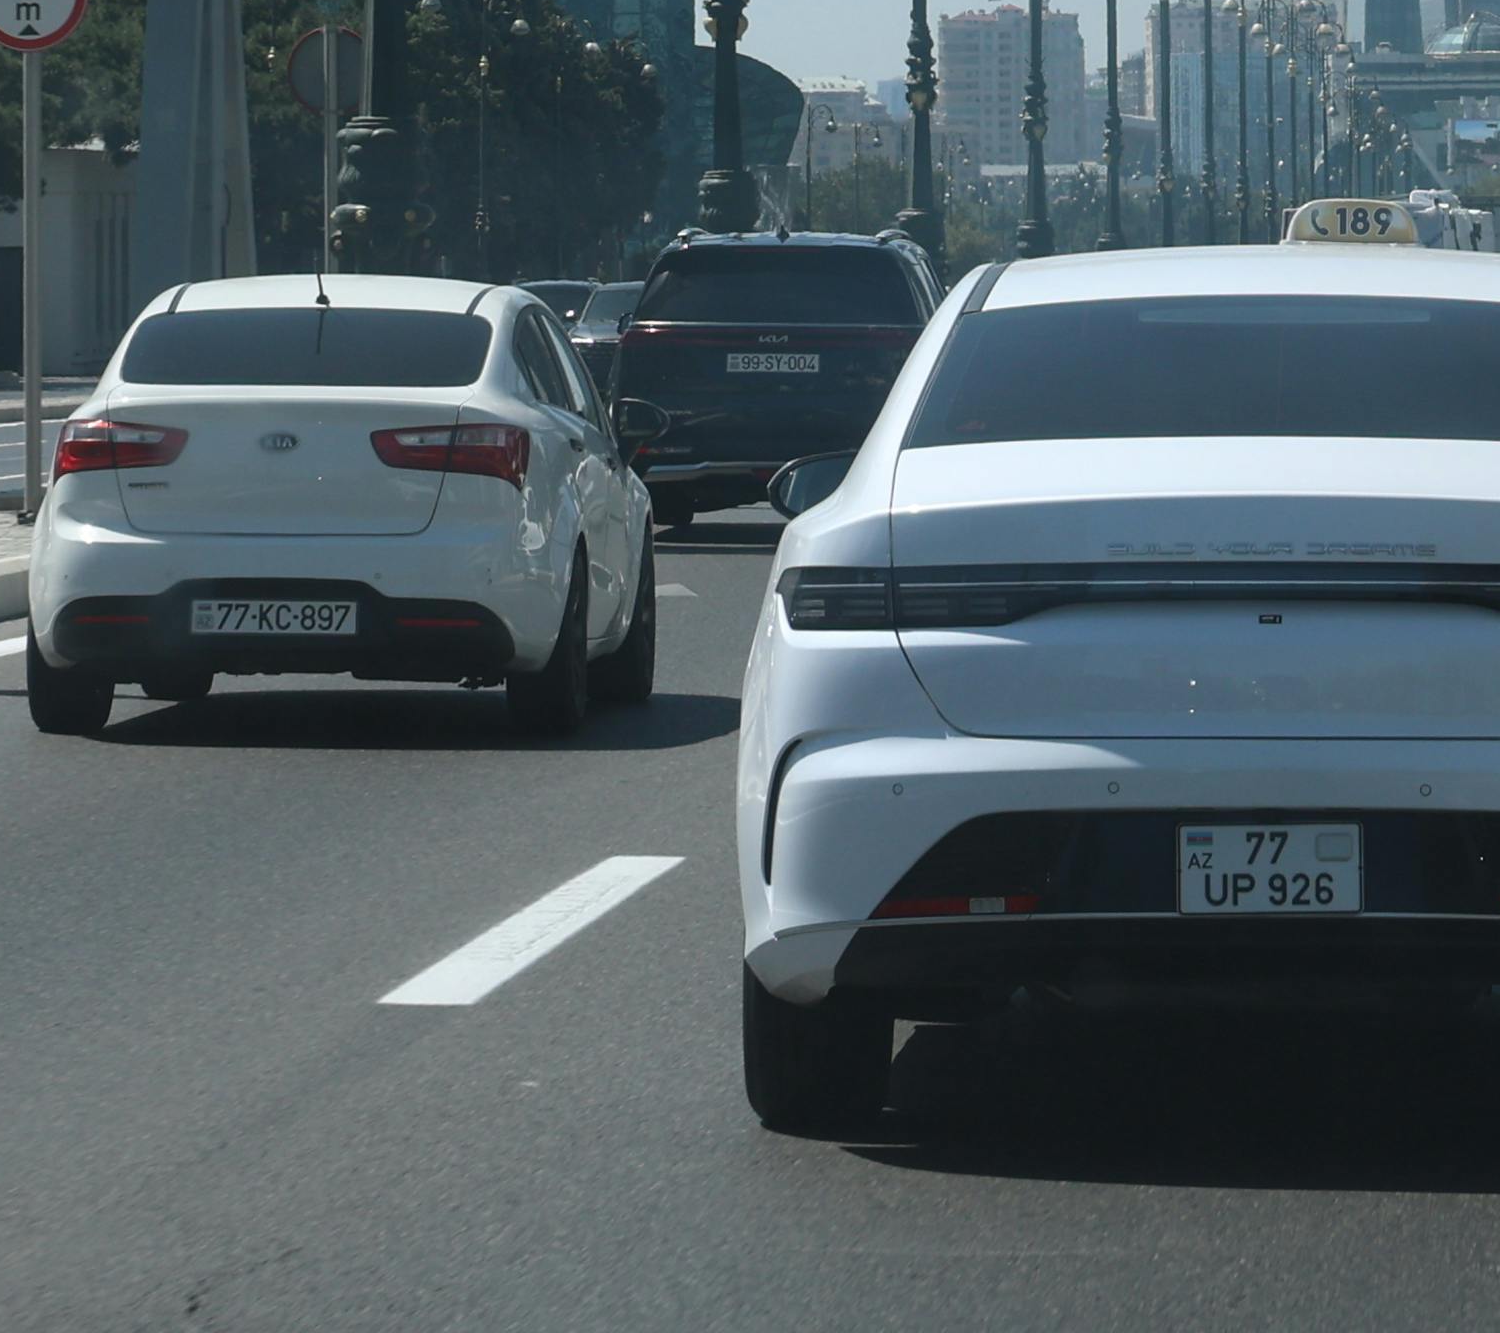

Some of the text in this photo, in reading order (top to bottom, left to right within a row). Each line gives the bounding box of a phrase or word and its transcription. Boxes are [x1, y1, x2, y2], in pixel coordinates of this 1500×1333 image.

[16, 2, 41, 21] m
[1335, 208, 1393, 235] 189
[741, 355, 816, 371] 99-SY-004
[217, 603, 350, 631] 77-KC-897
[1187, 831, 1289, 869] AZ 77
[1204, 872, 1334, 907] UP 926
